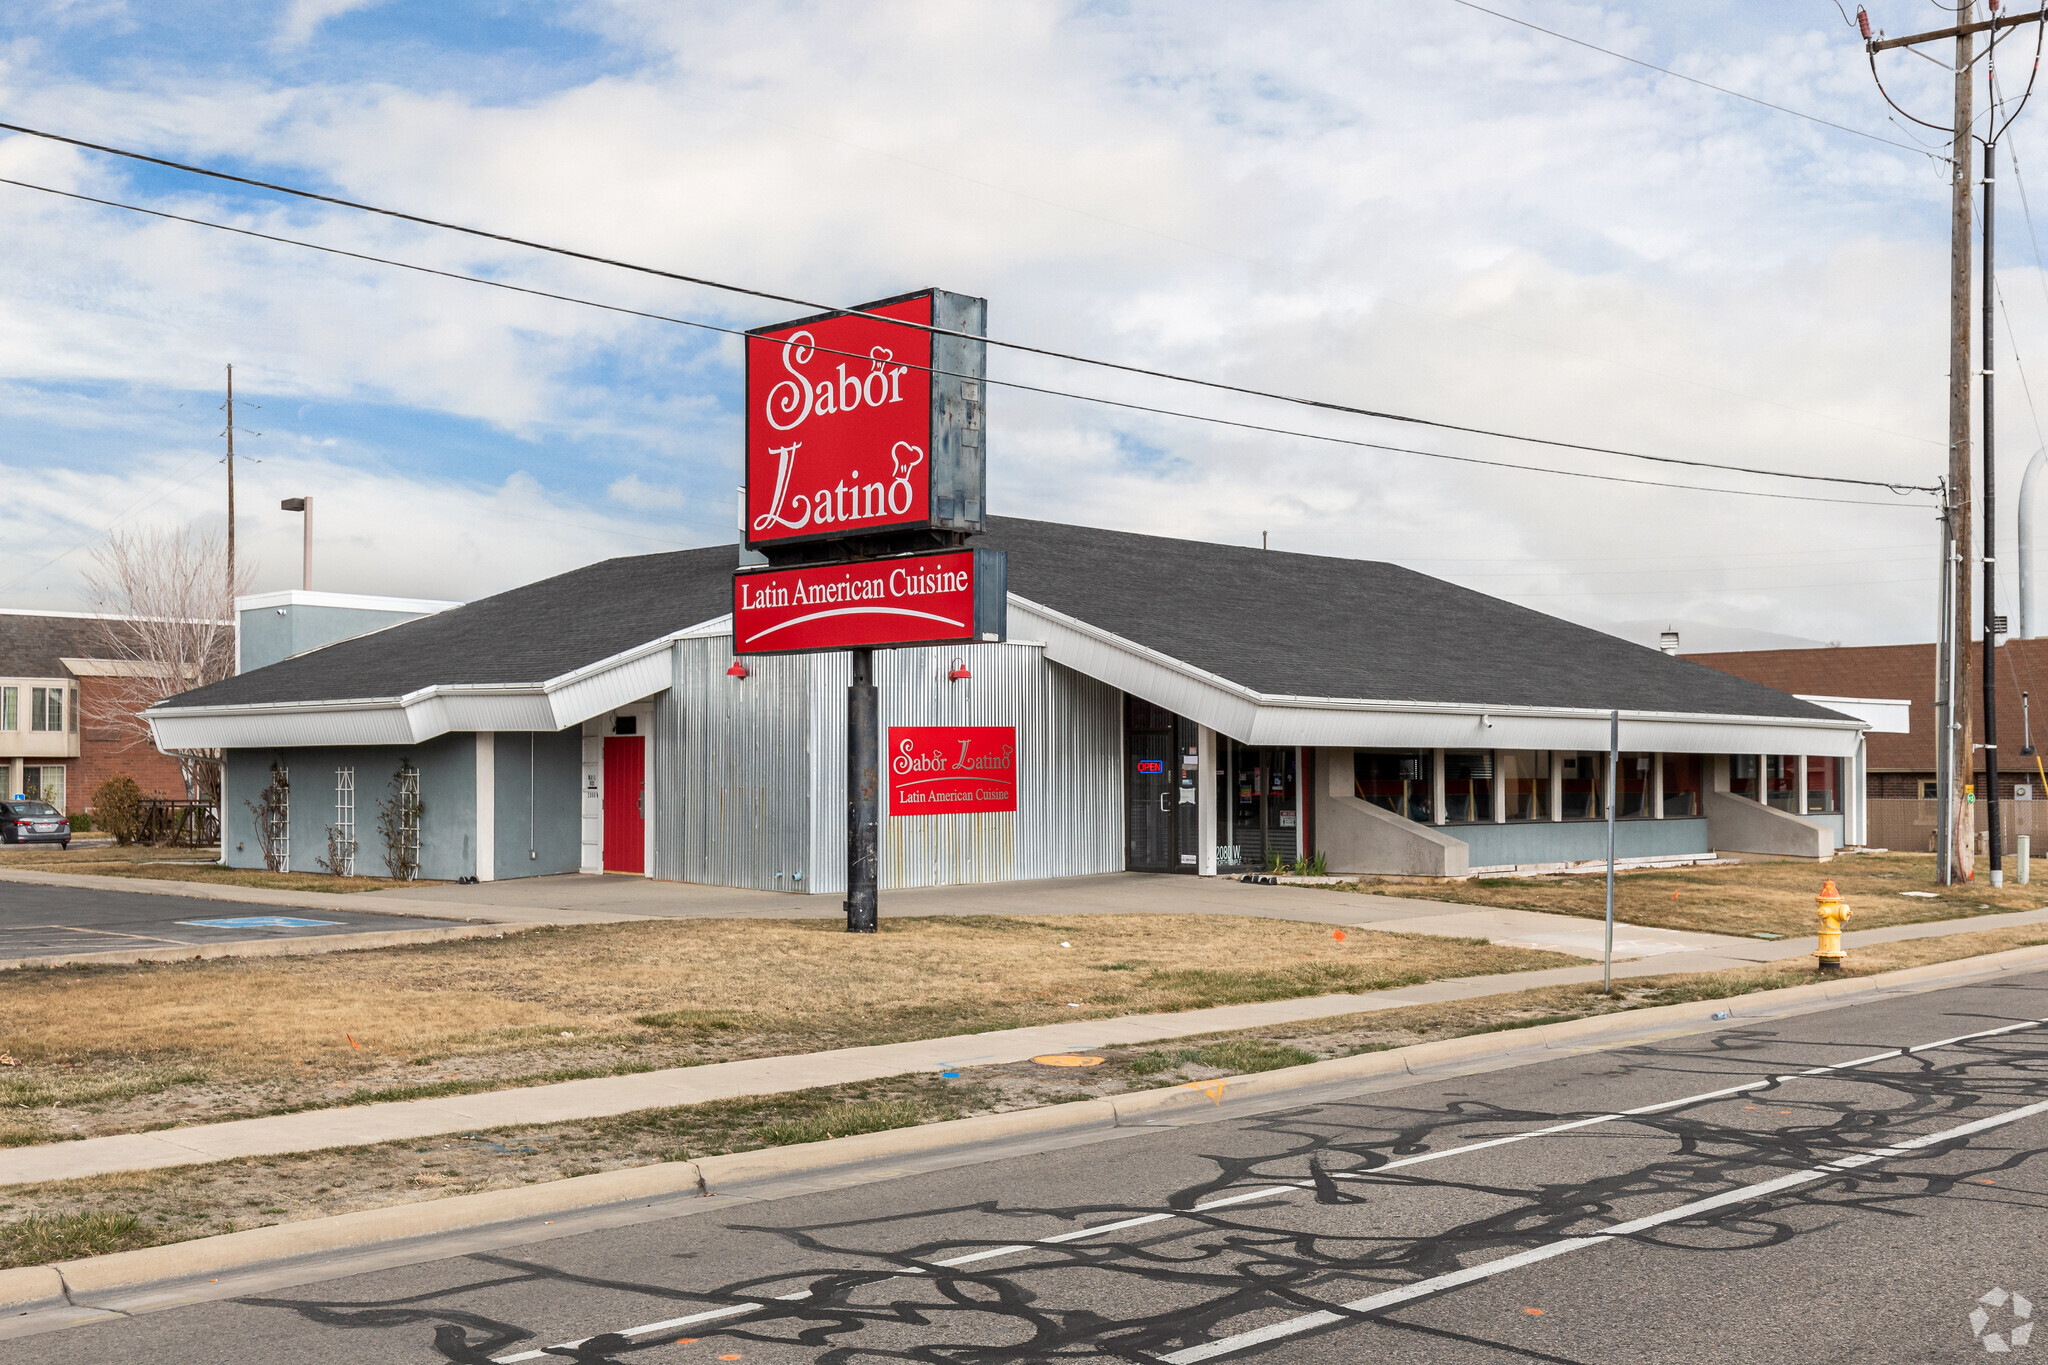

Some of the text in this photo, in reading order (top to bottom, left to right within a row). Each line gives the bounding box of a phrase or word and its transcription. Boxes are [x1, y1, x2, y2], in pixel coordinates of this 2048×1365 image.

[766, 330, 907, 431] Sabor
[754, 441, 915, 531] Latino
[741, 564, 969, 610] Latin American Cuisine
[893, 738, 1011, 775] Sabor Latino
[1138, 762, 1160, 771] OPEN
[899, 788, 1009, 804] Latin American Cuisine
